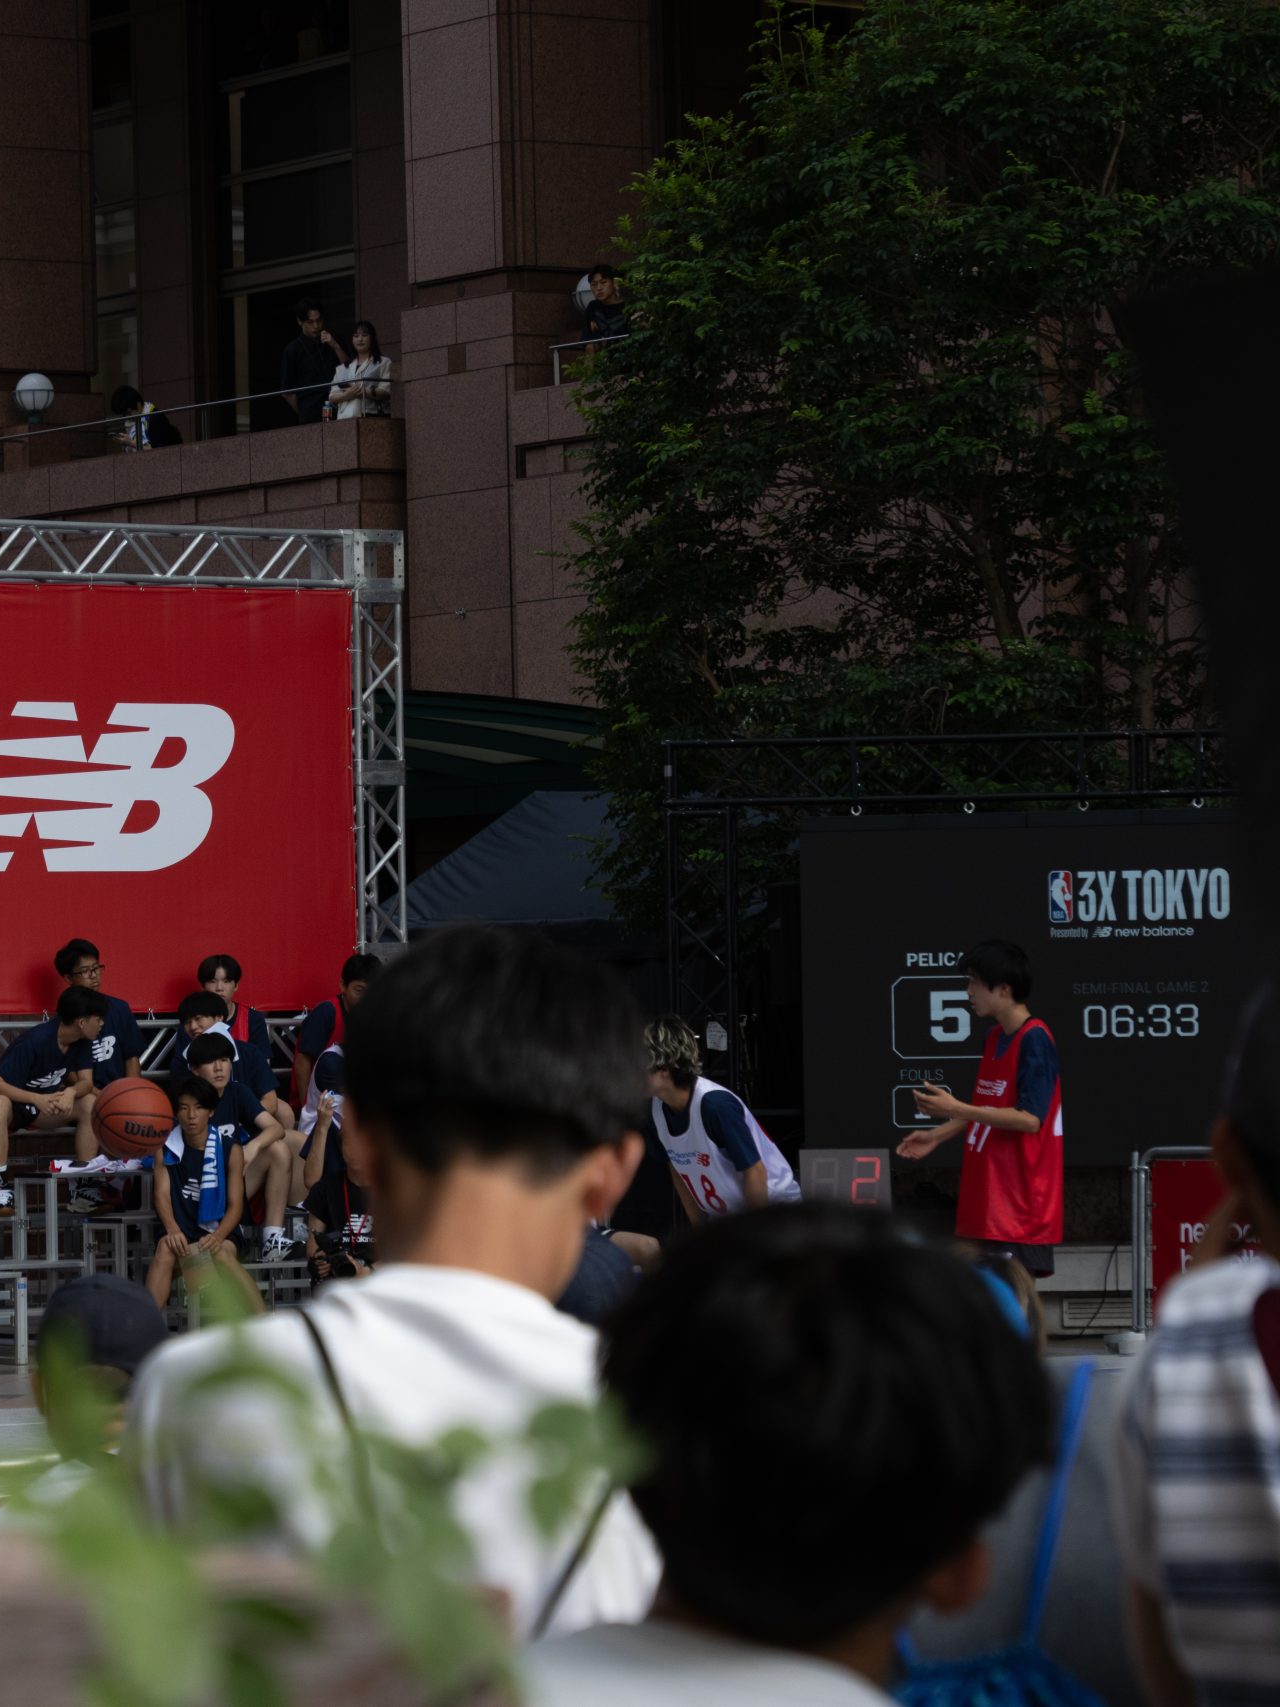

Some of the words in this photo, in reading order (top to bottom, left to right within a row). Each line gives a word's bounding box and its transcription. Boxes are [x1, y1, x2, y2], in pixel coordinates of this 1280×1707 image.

[1077, 869, 1117, 922] 3X
[1121, 867, 1231, 921] TOKYO
[1114, 928, 1140, 938] new
[1142, 926, 1195, 937] balance
[906, 952, 964, 967] PELIC
[1072, 982, 1152, 995] SEMI-FINAL
[1156, 981, 1198, 994] GAME
[1201, 981, 1210, 993] 2
[929, 990, 971, 1042] 5
[1083, 1003, 1200, 1039] 06:33
[900, 1068, 944, 1081] FOULS
[680, 1173, 728, 1215] 18
